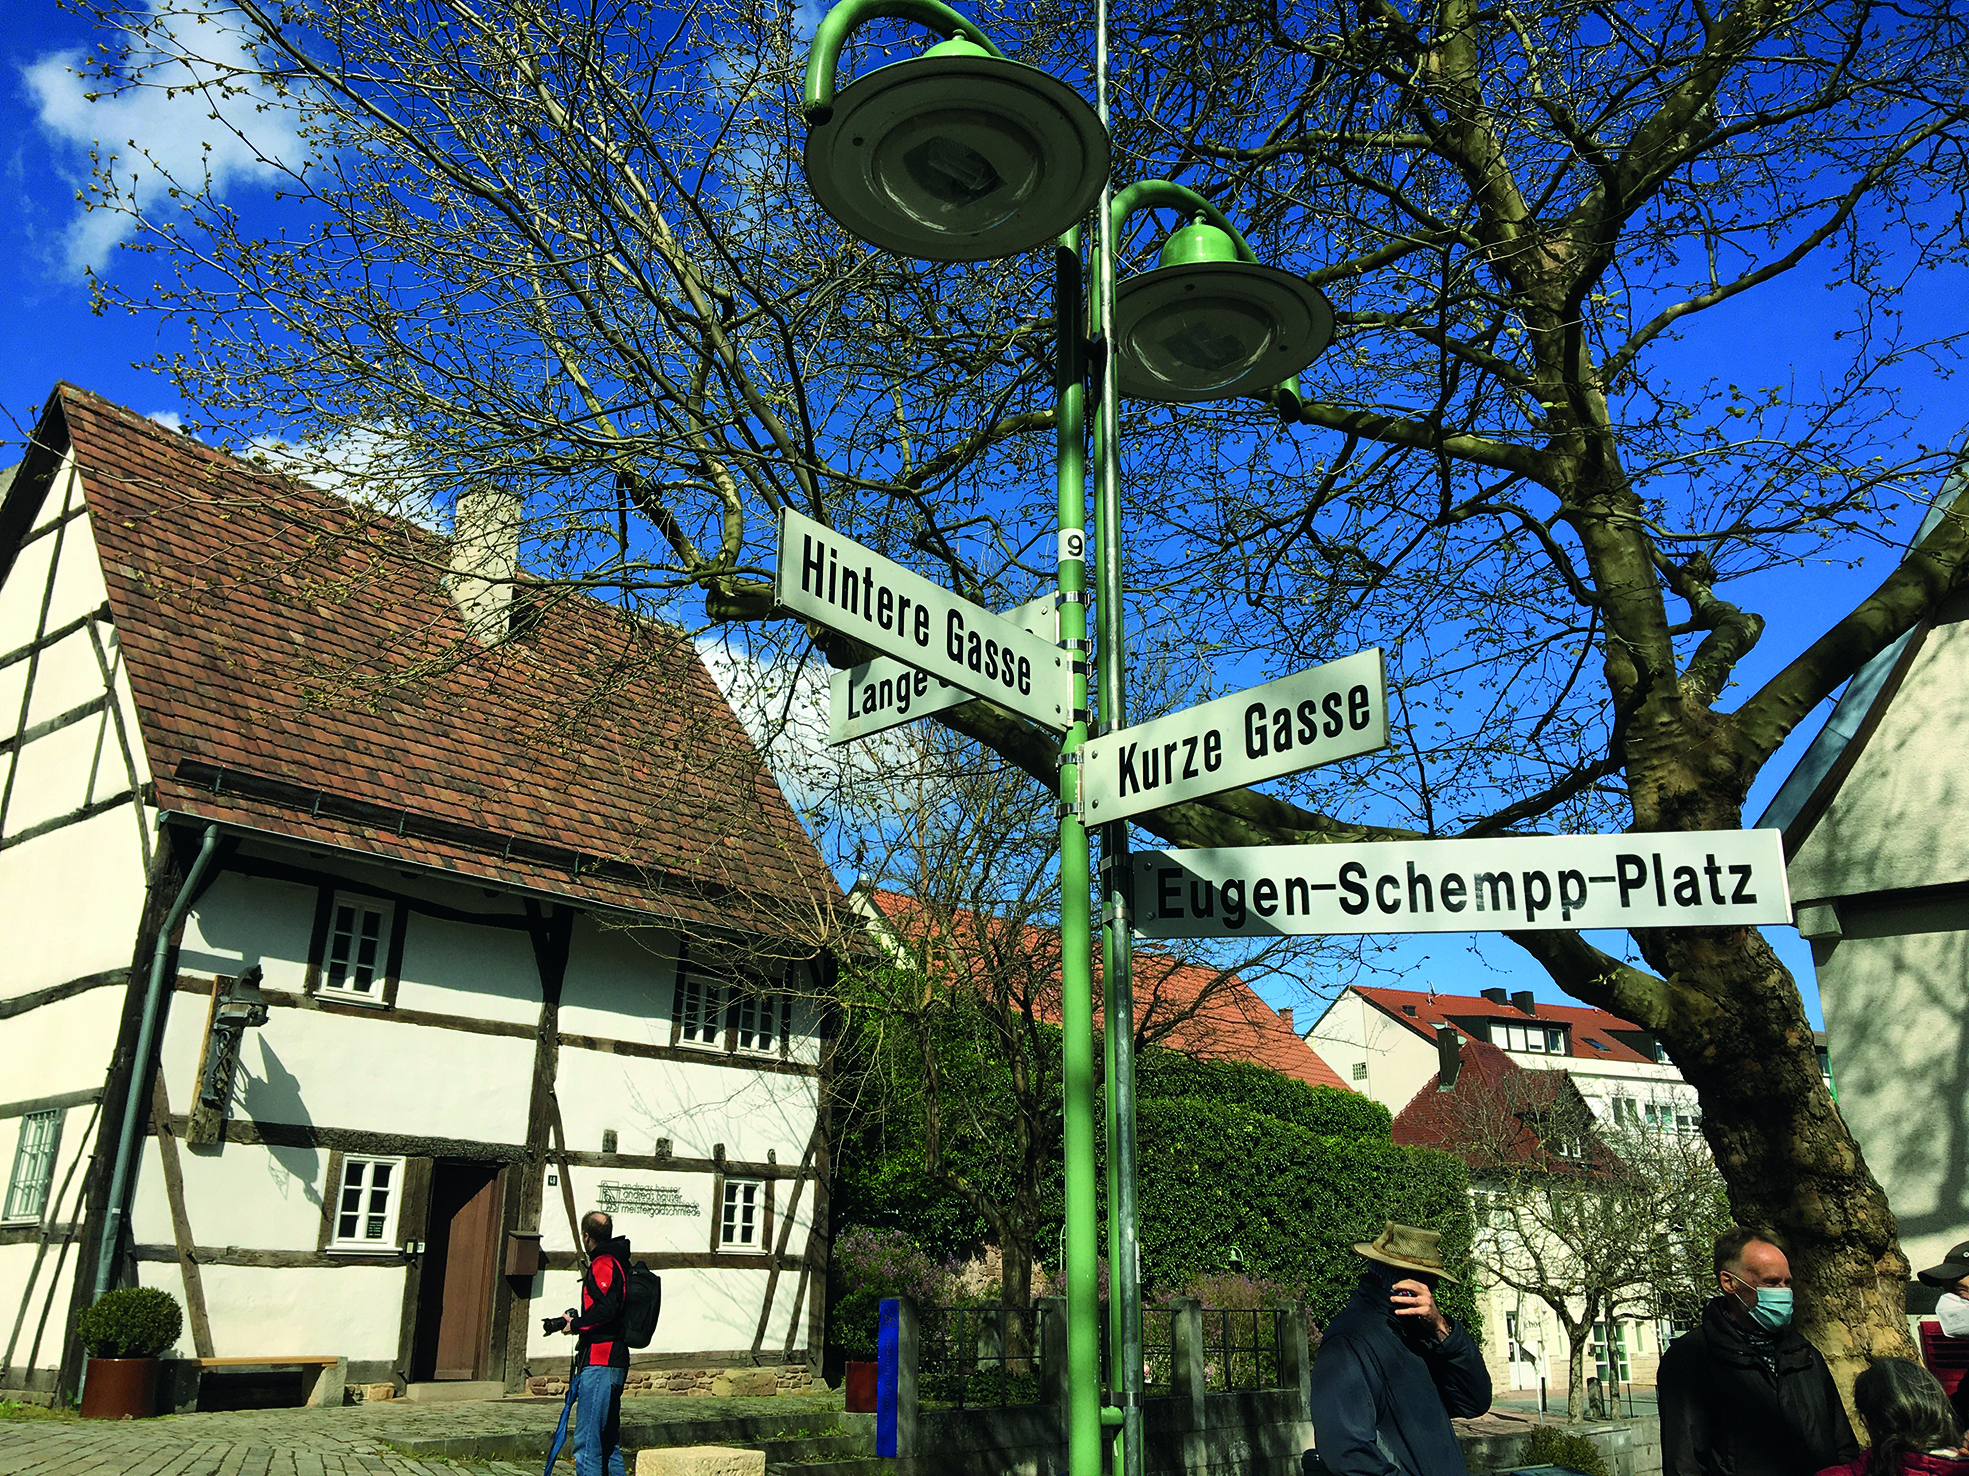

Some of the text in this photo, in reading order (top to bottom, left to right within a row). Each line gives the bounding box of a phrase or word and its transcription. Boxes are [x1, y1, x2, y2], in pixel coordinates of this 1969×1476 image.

[1067, 534, 1083, 557] 9
[801, 533, 930, 648] Hintere
[946, 608, 1031, 696] Gasse
[847, 669, 928, 721] Lange
[1118, 684, 1371, 799] Kurze Gasse
[1156, 853, 1759, 929] Eugen-Schempp-Platz
